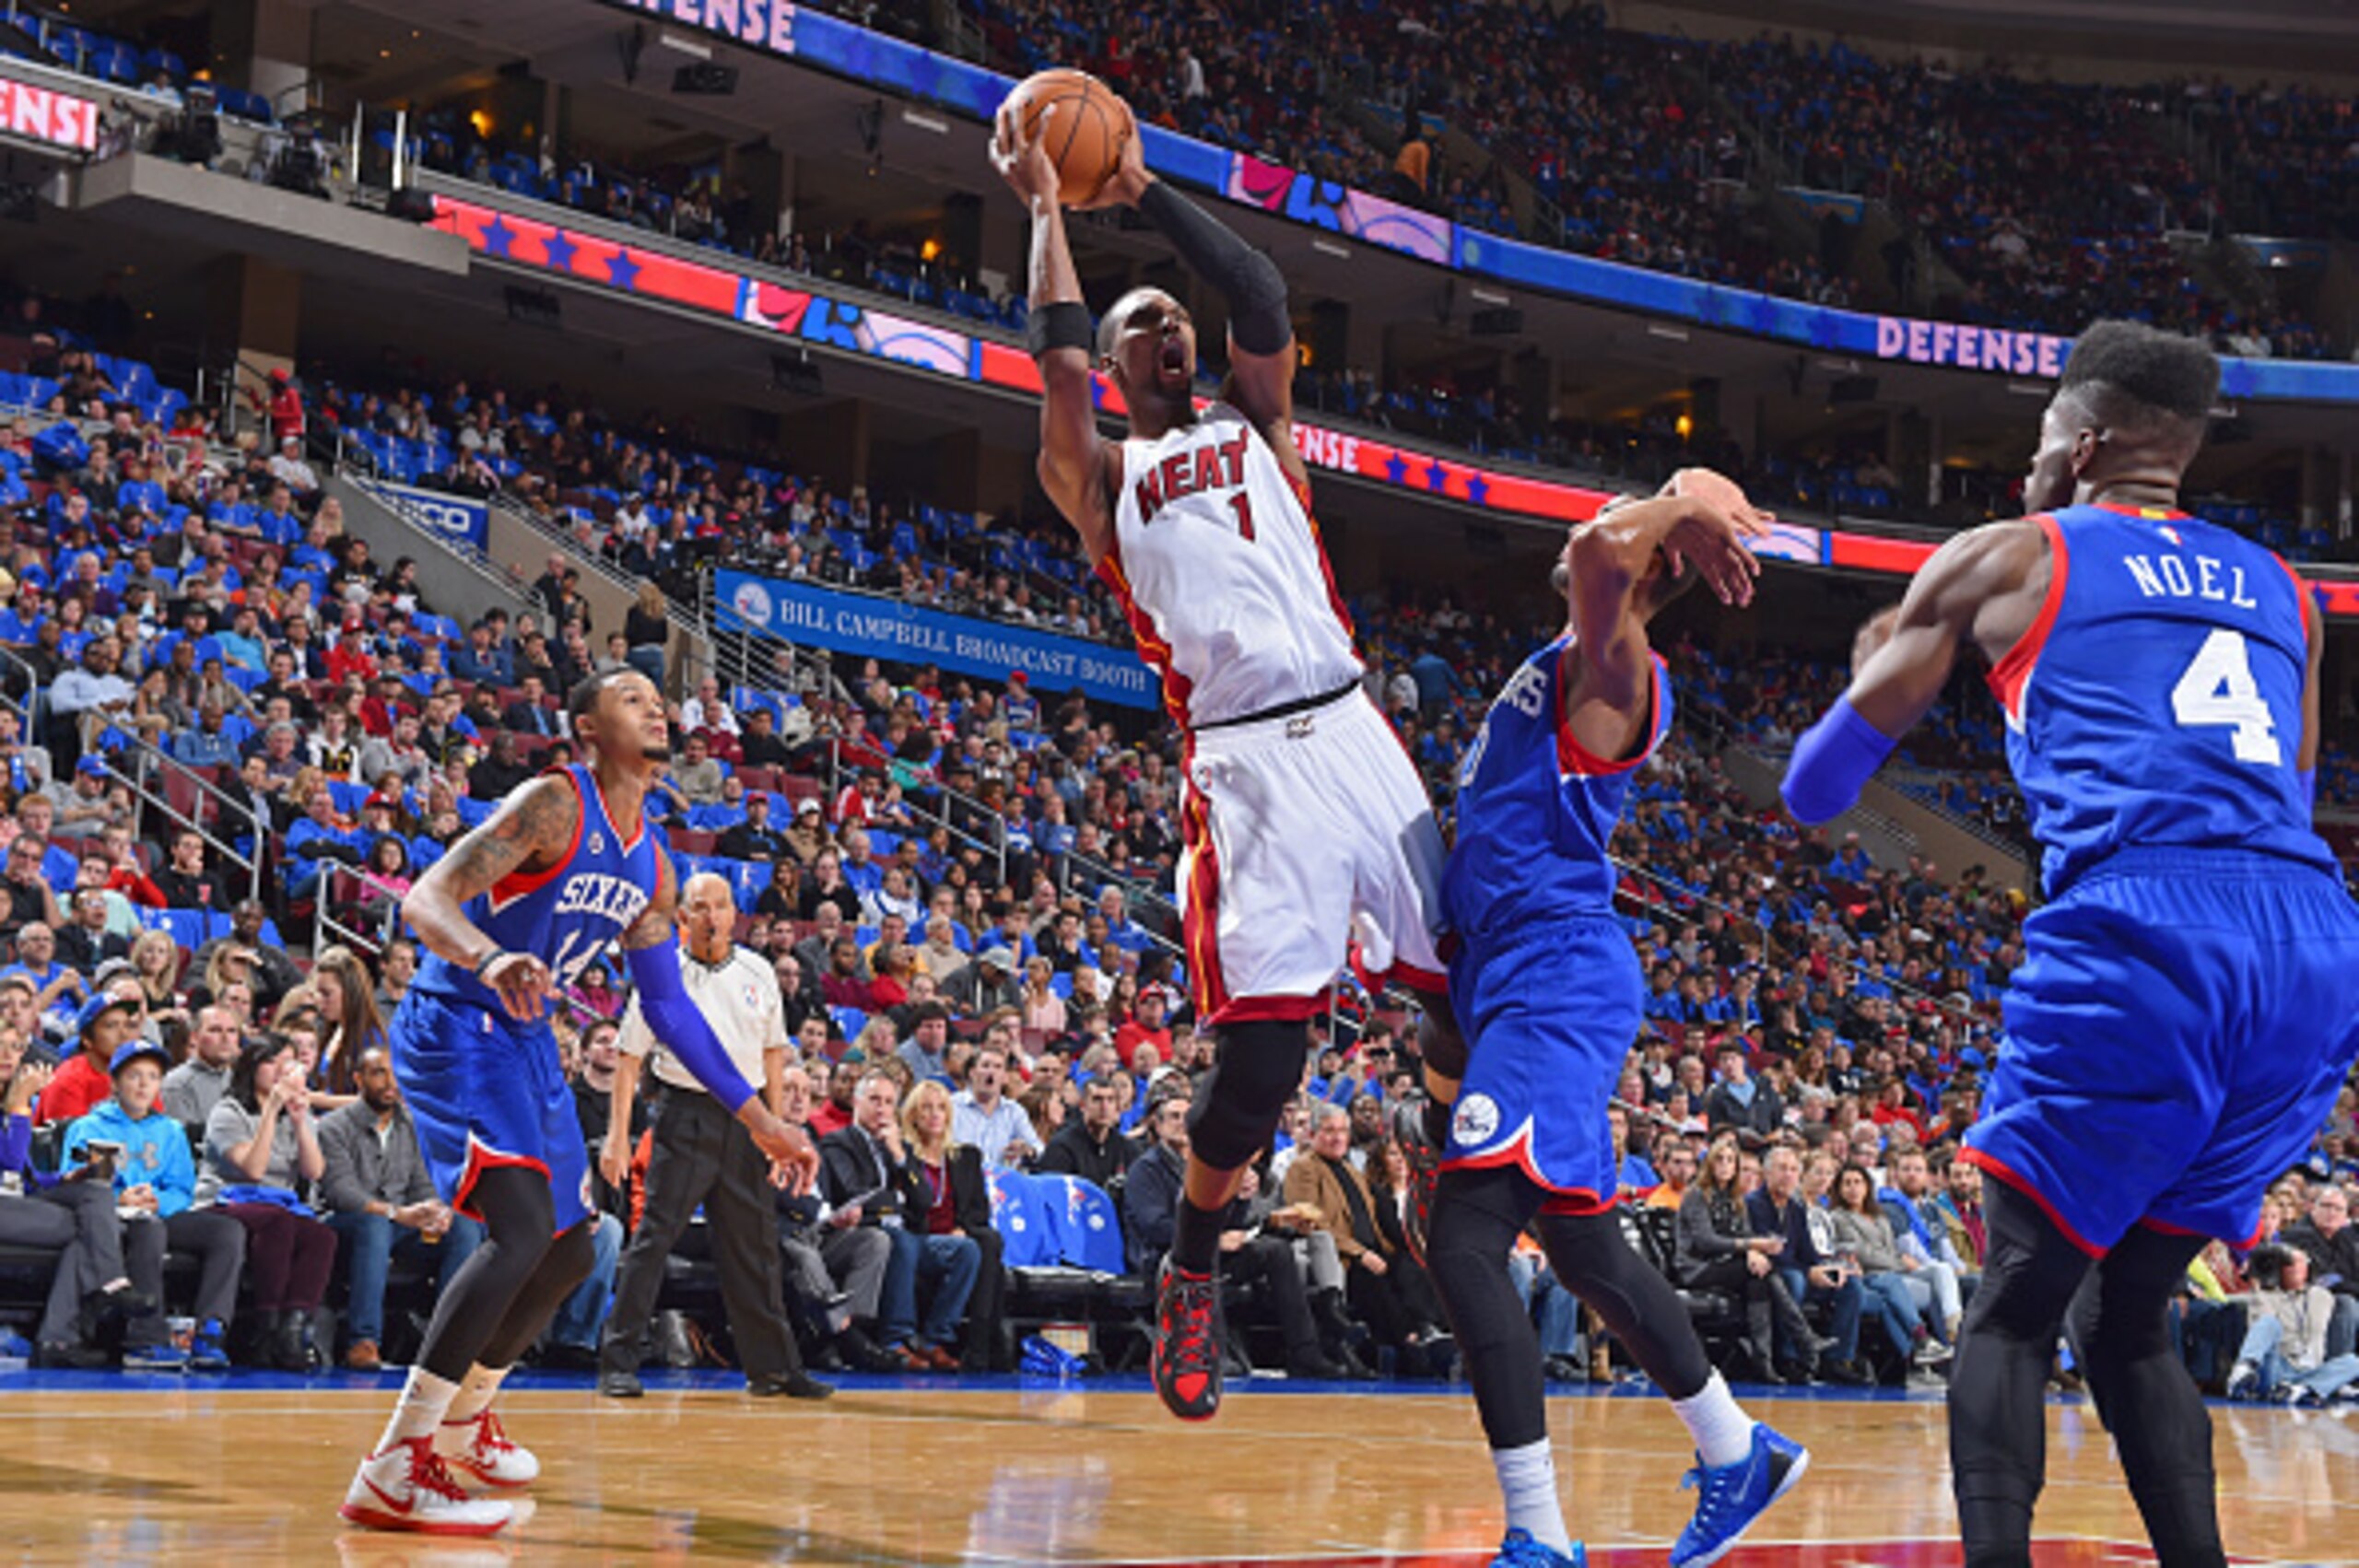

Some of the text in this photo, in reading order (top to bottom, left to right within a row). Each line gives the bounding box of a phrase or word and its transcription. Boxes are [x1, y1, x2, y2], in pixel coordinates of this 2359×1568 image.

[1877, 316, 2060, 378] DEFENSE
[1135, 425, 1249, 528] HEAT
[1227, 489, 1256, 544] 1
[2123, 555, 2258, 609] NOEL
[781, 599, 829, 631] BILL
[837, 611, 950, 653] CAMPBELL
[956, 633, 1076, 677] BROADCAST
[1079, 658, 1145, 691] BOOTH
[2170, 626, 2282, 767] 4
